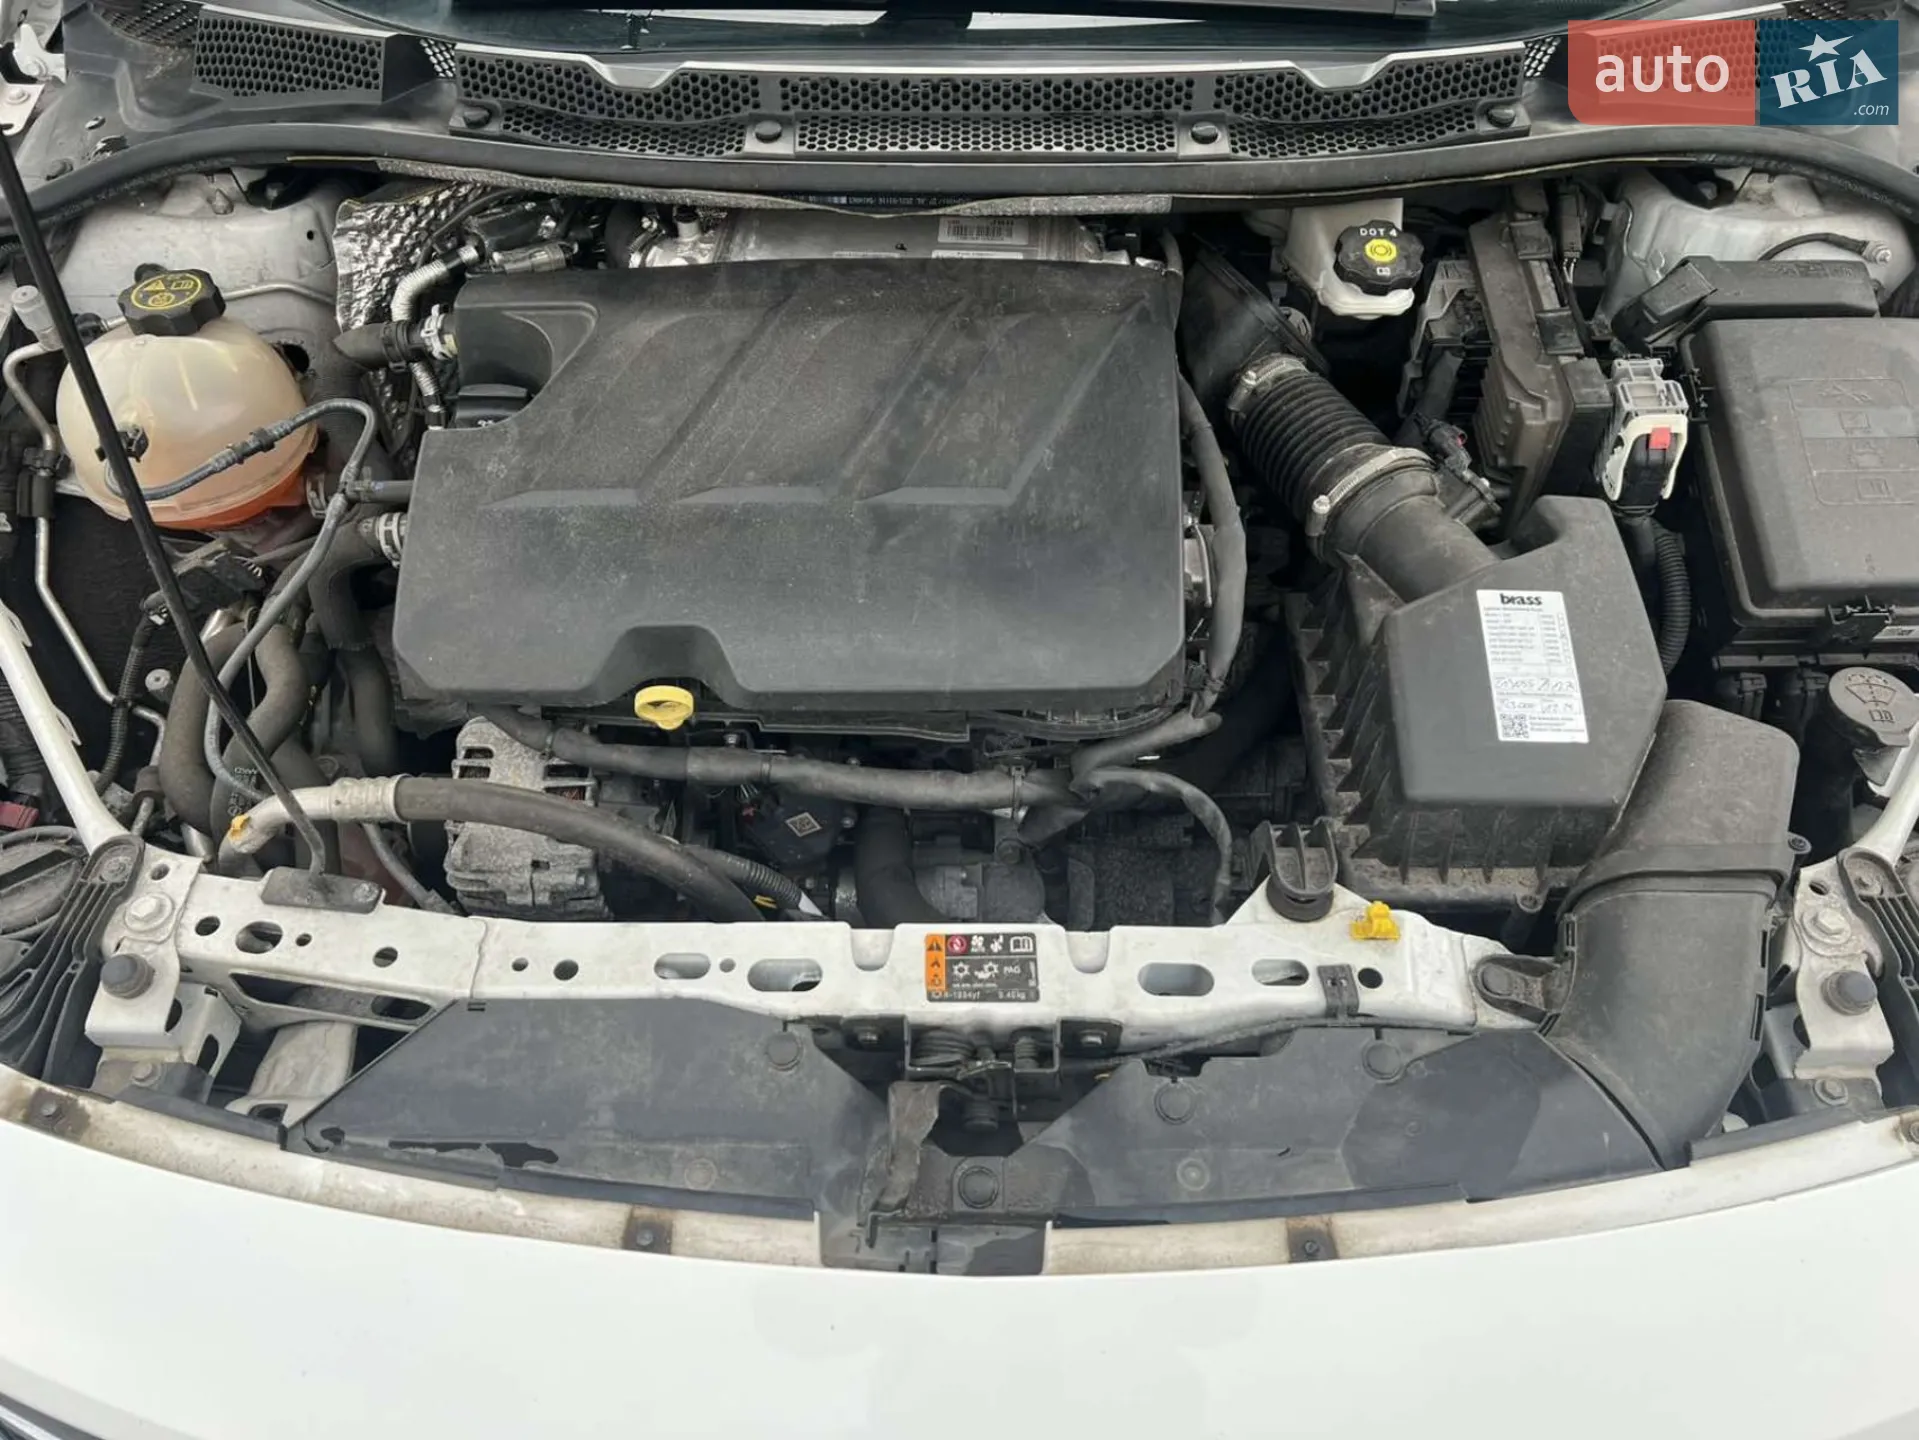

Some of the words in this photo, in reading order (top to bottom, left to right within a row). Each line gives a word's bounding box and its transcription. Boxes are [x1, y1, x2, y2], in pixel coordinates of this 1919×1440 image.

[1359, 228, 1386, 236] DOT
[1389, 228, 1398, 237] 4
[1499, 592, 1543, 606] brass
[1003, 965, 1021, 974] PAG
